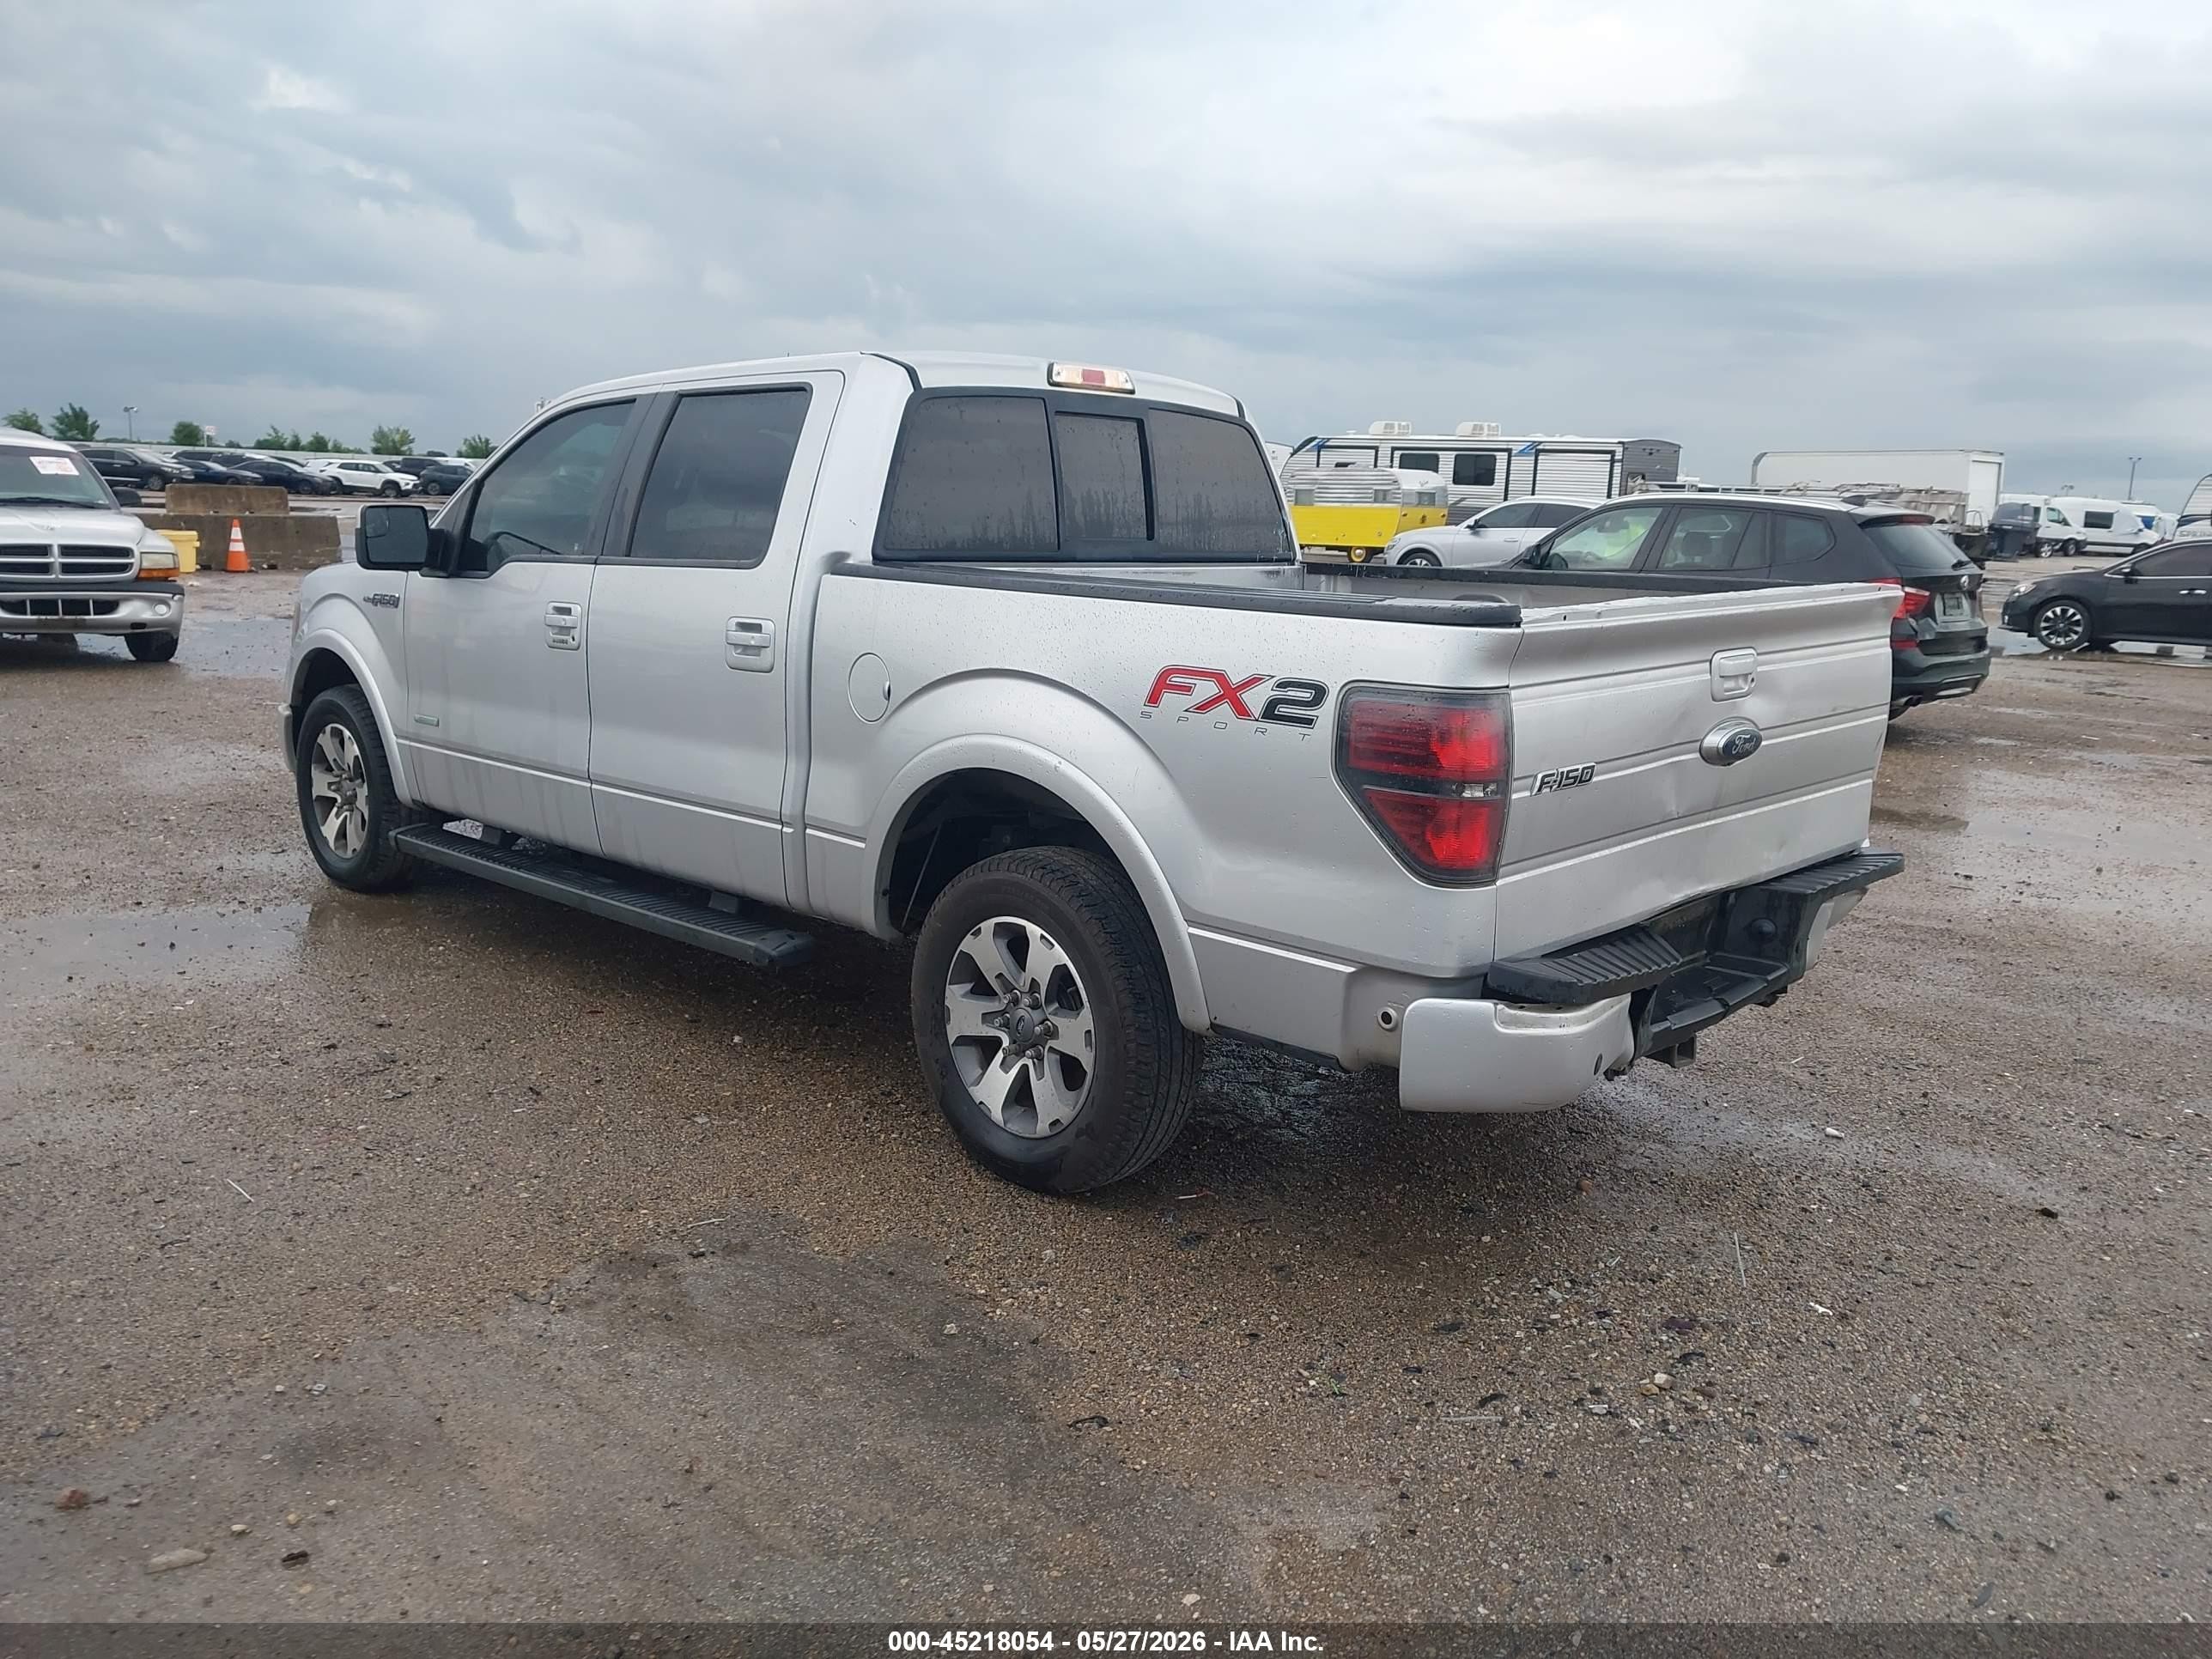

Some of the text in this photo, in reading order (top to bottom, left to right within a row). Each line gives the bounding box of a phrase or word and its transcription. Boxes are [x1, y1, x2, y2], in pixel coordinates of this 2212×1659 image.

[1144, 665, 1329, 729] FX2
[1139, 710, 1310, 741] SPORT
[1731, 733, 1757, 755] Ford
[1530, 762, 1596, 797] F-150
